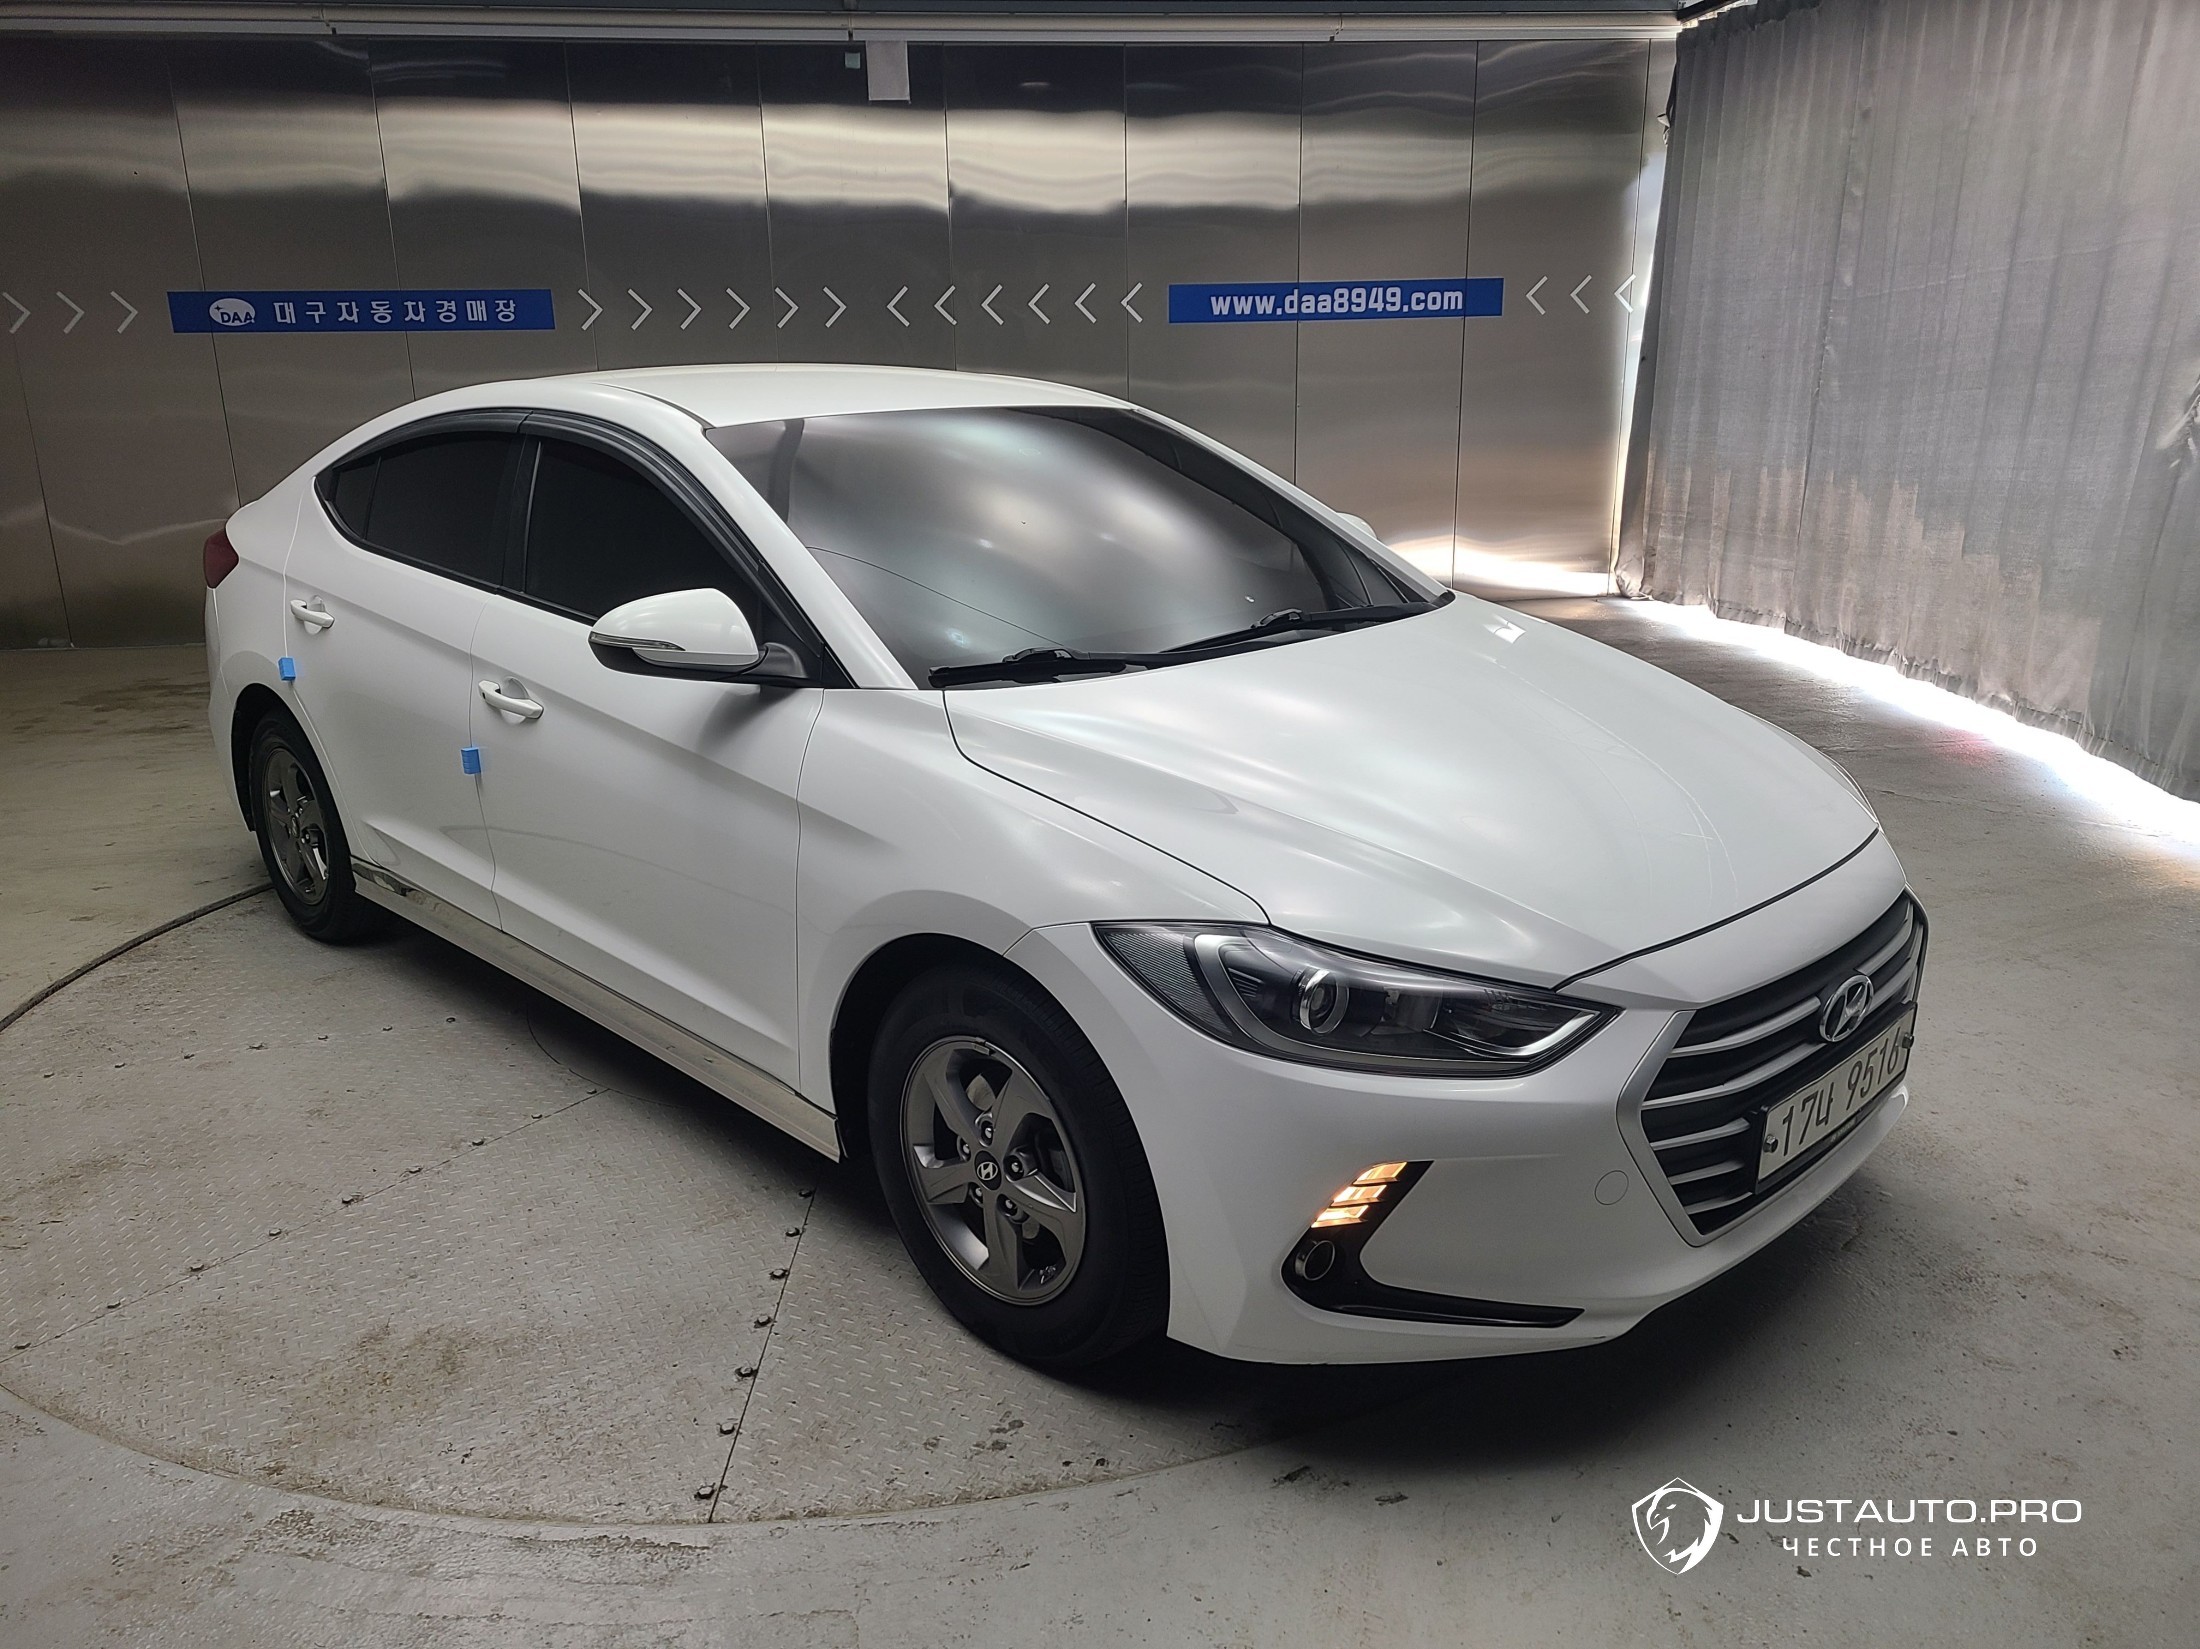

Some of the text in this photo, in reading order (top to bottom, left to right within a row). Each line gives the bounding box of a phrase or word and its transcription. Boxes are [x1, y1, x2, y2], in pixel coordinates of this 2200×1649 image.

[220, 299, 516, 324] DAA 대구자동차경매장
[1210, 287, 1463, 316] www.daa8949.com
[1782, 1026, 1901, 1157] 17나 9516
